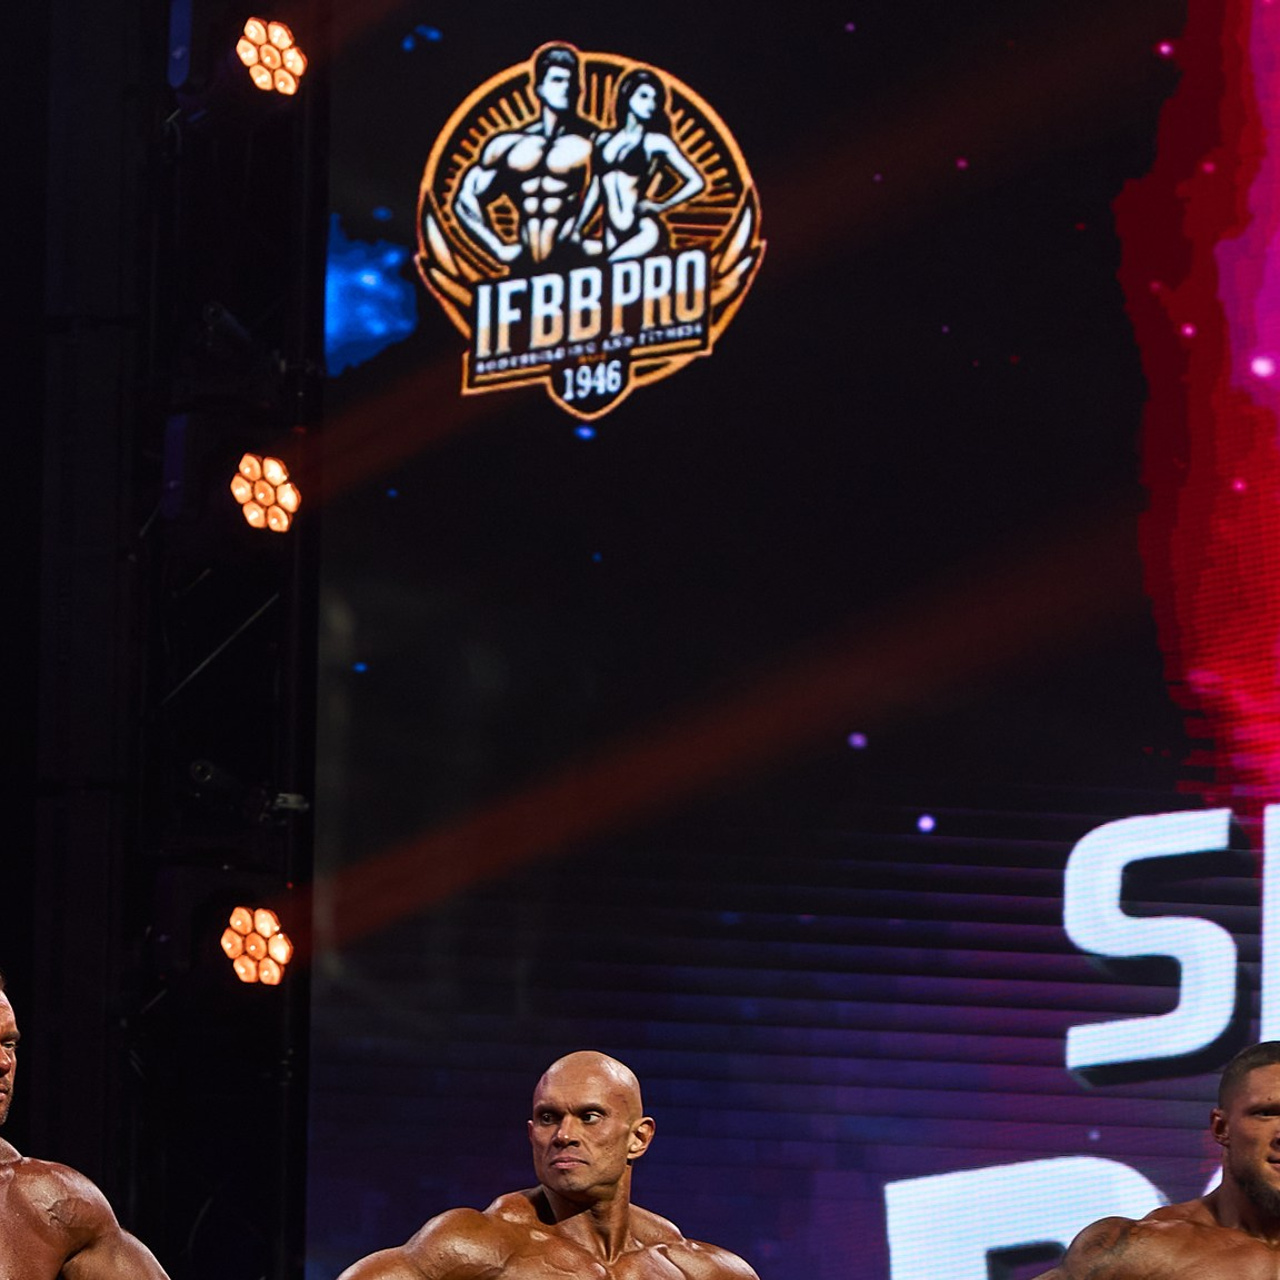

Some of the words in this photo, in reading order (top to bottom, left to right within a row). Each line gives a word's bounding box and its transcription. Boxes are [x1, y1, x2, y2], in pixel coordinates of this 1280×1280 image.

[475, 267, 602, 358] IFBB
[610, 250, 706, 336] PRO
[563, 360, 622, 400] 1946
